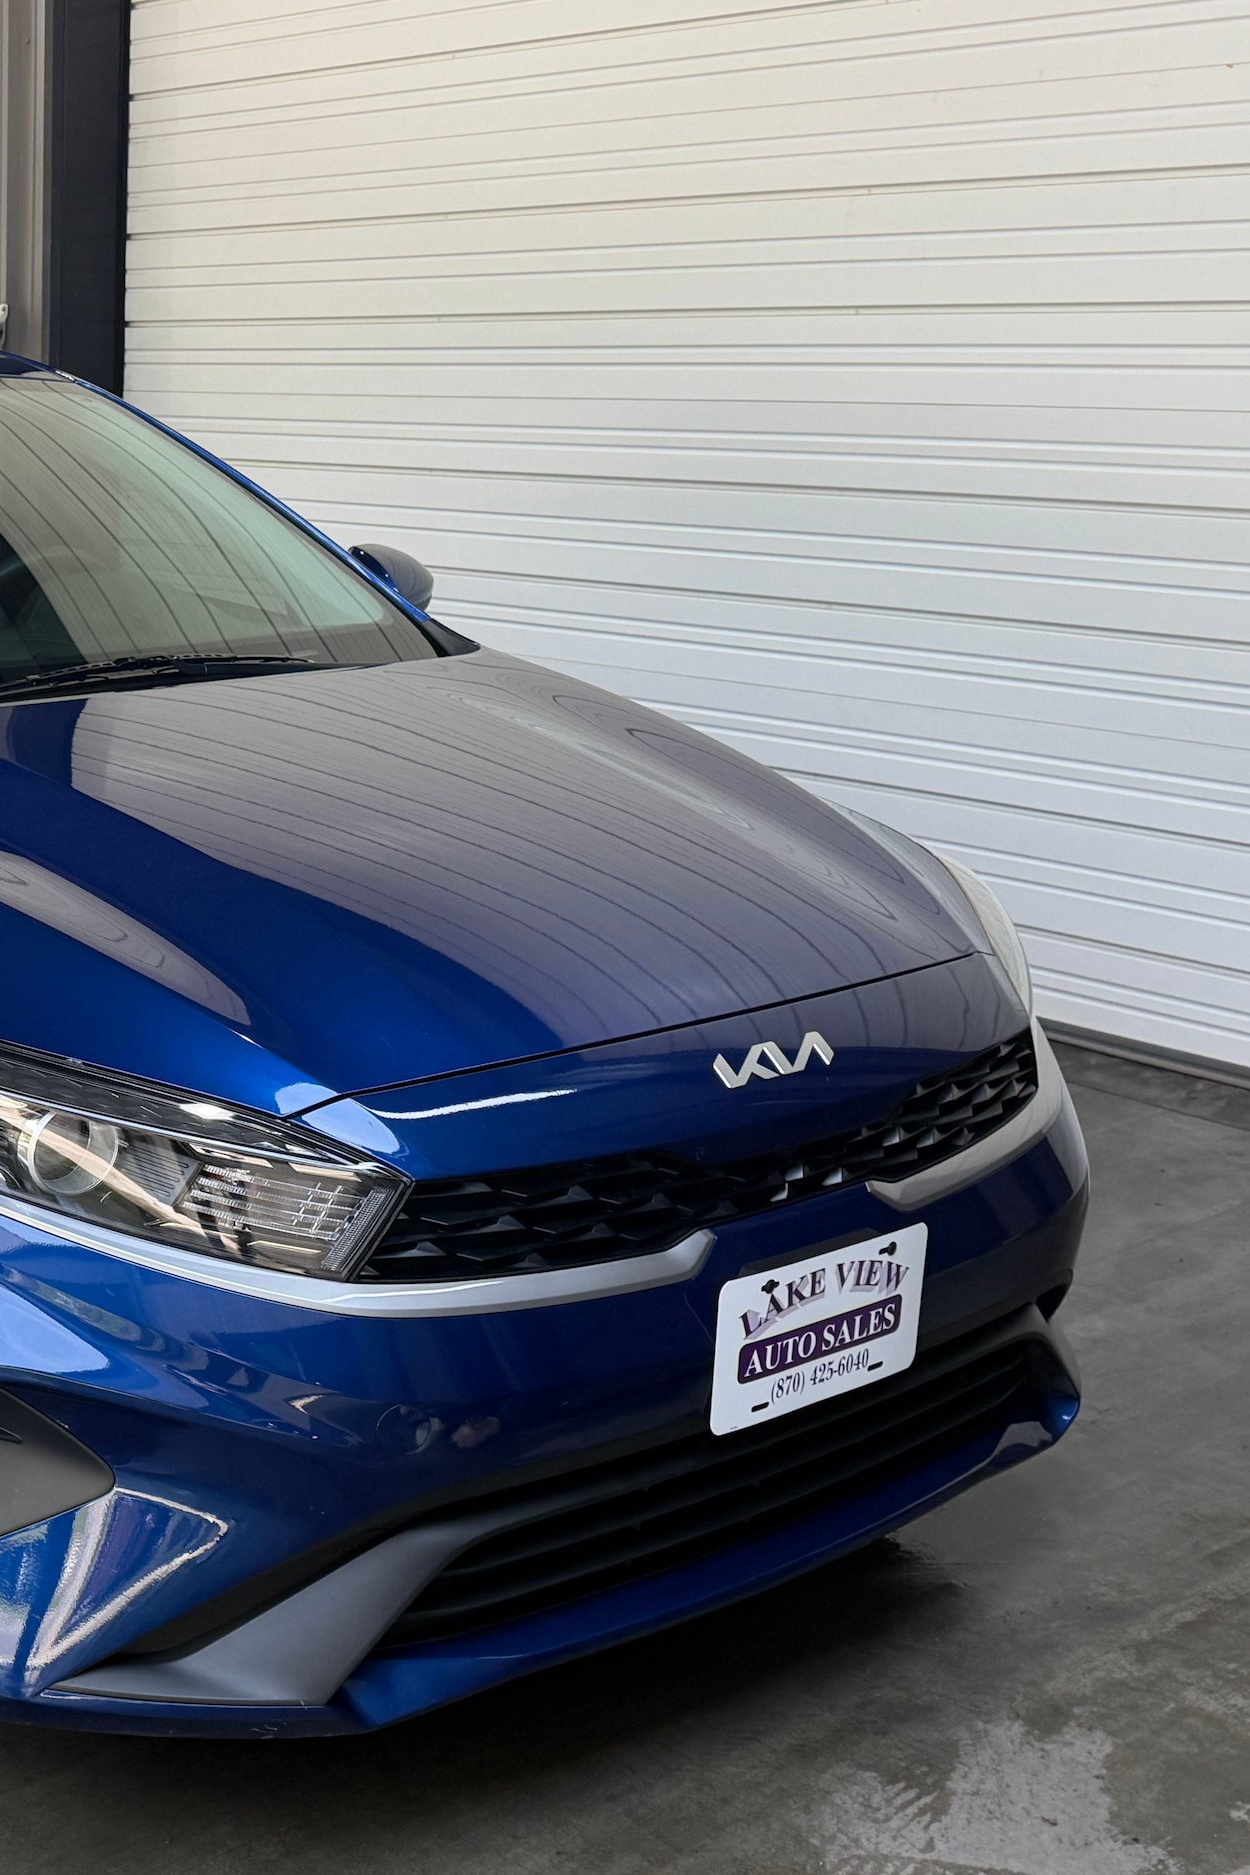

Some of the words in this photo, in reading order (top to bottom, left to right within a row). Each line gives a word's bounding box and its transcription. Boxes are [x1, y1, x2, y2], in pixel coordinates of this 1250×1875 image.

[713, 1031, 835, 1089] KIA
[738, 1267, 826, 1340] LAKE
[835, 1259, 910, 1295] VIEW
[743, 1331, 817, 1378] AUTO
[821, 1303, 896, 1350] SALES
[770, 1370, 806, 1405] (870)
[809, 1348, 869, 1387] 425-6040
